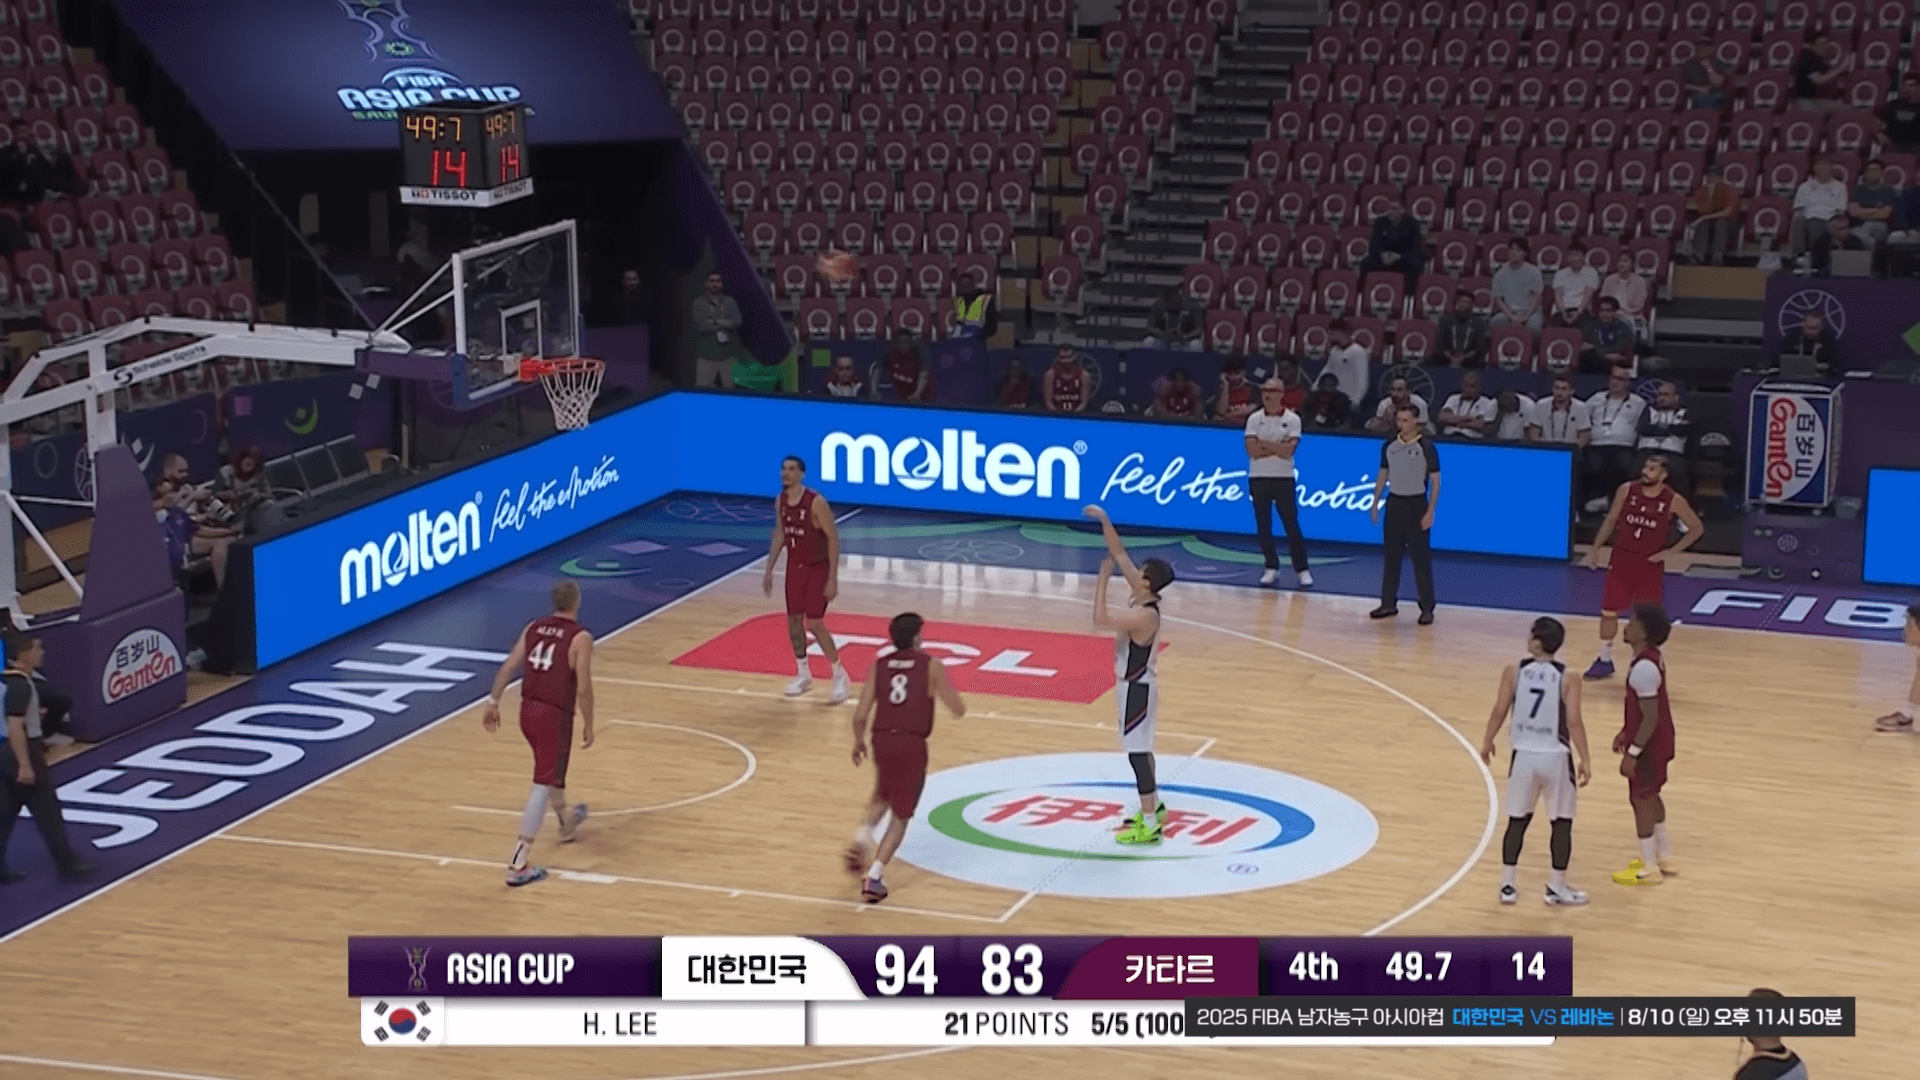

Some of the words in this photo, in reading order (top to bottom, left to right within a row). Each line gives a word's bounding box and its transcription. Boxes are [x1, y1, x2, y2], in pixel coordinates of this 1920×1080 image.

[337, 87, 434, 110] ASIA
[405, 115, 461, 142] 49:7
[432, 149, 467, 189] 14
[500, 143, 520, 183] 14
[432, 191, 478, 201] TISSOT
[820, 428, 1081, 500] molten
[1100, 452, 1184, 507] feel
[1181, 467, 1247, 504] the
[488, 480, 530, 543] feel
[527, 479, 557, 520] the
[1626, 514, 1658, 529] QATAR
[339, 500, 481, 606] molten
[1689, 589, 1909, 629] FIB
[116, 635, 160, 669] 百岁山
[528, 640, 557, 671] 44
[805, 631, 1059, 678] TCL
[889, 673, 909, 704] 8
[1529, 687, 1546, 718] 7
[17, 641, 510, 849] JEDDAH
